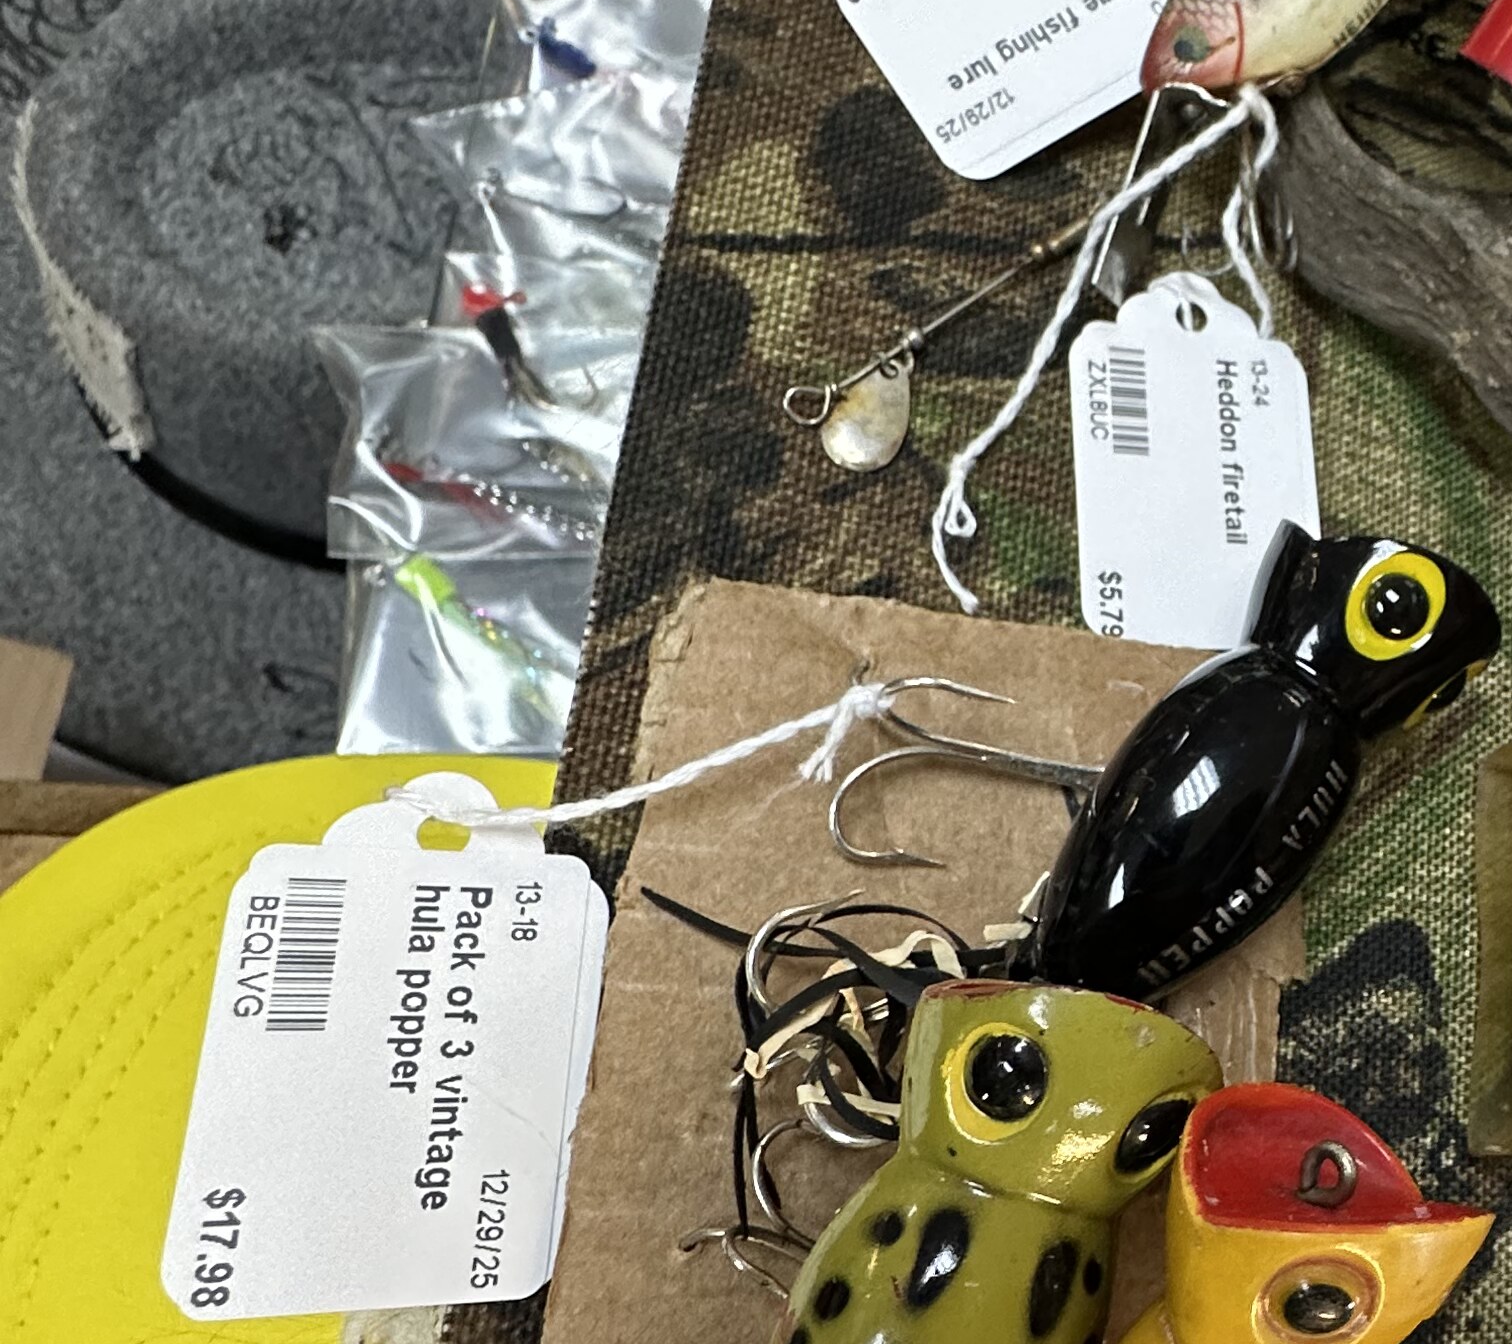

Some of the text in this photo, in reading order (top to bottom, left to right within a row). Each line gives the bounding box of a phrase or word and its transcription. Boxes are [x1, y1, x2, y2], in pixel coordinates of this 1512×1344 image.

[946, 56, 994, 90] lure
[995, 7, 1081, 65] fishing
[935, 87, 1016, 144] 12/29/25
[1250, 360, 1270, 407] 13-24
[1216, 359, 1248, 545] Heddon firetail
[1098, 571, 1124, 638] $5.79
[1281, 759, 1349, 852] HULA
[232, 894, 281, 1019] BEQLVG
[386, 885, 450, 1094] hula popper
[414, 886, 494, 1211] Pack of 3 vintage
[470, 881, 542, 1290] 13-18 12/29/25
[190, 1187, 247, 1308] $17.98
